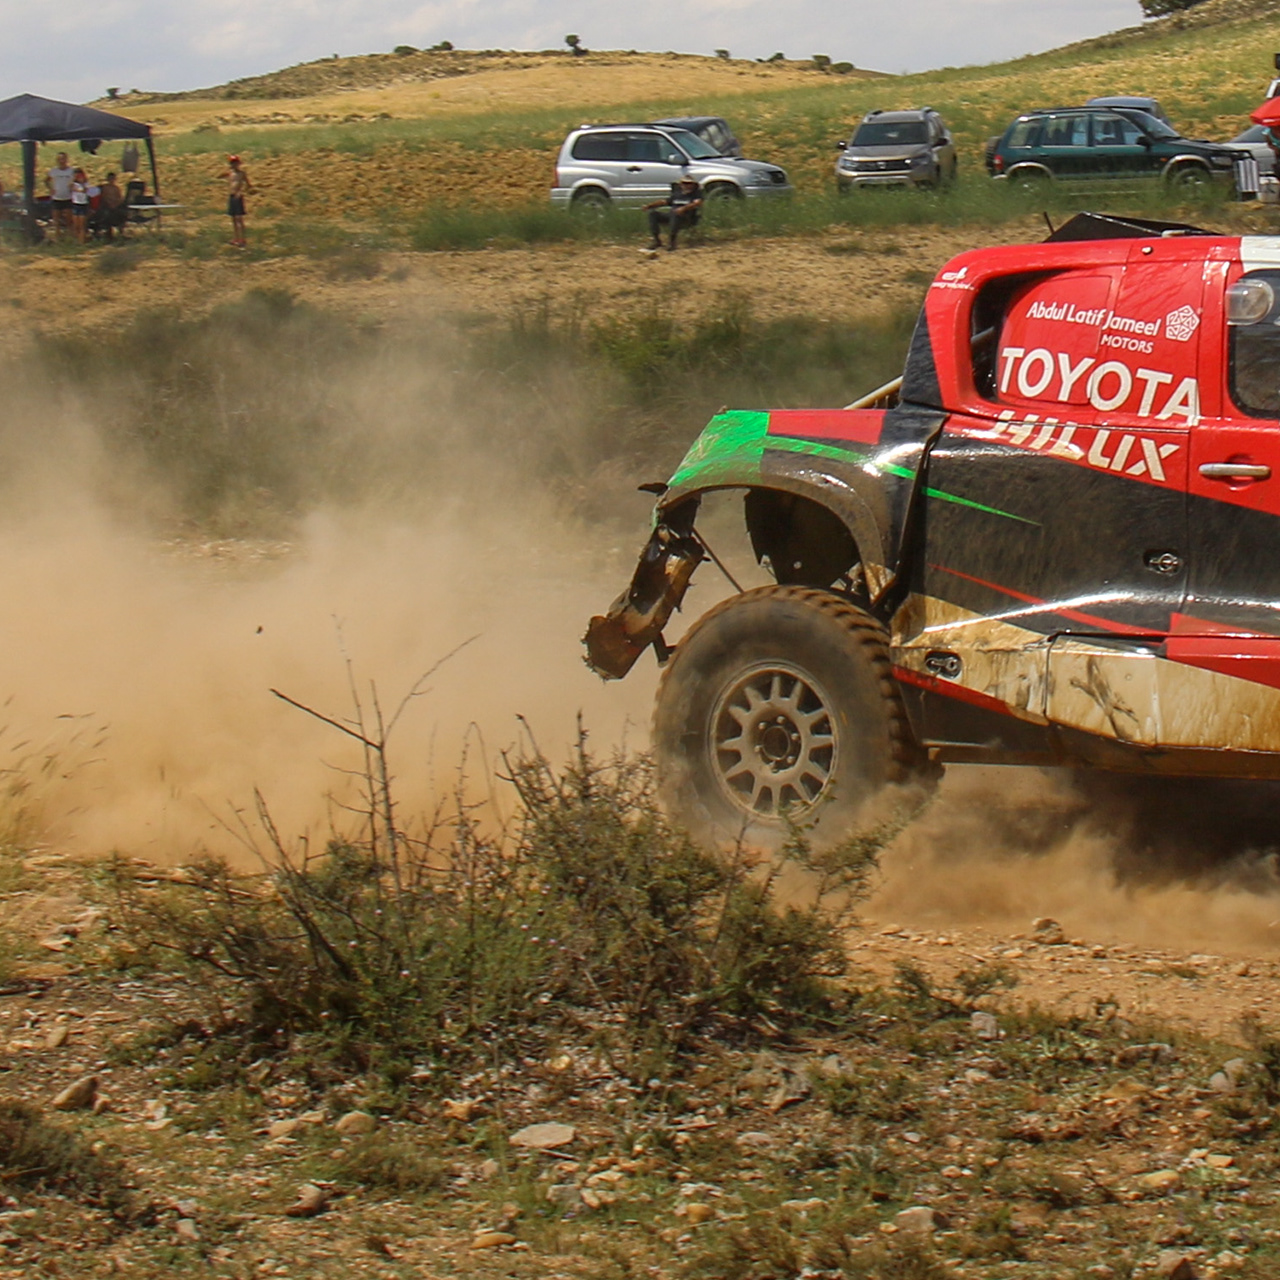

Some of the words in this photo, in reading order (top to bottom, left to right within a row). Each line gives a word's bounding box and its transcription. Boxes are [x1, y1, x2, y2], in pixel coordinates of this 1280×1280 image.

[1026, 301, 1068, 321] Abdul
[1066, 304, 1106, 326] Latif
[1102, 311, 1161, 336] Jameel
[1101, 334, 1153, 354] MOTORS
[1000, 347, 1201, 426] TOYOTA
[992, 410, 1180, 482] HILUX
